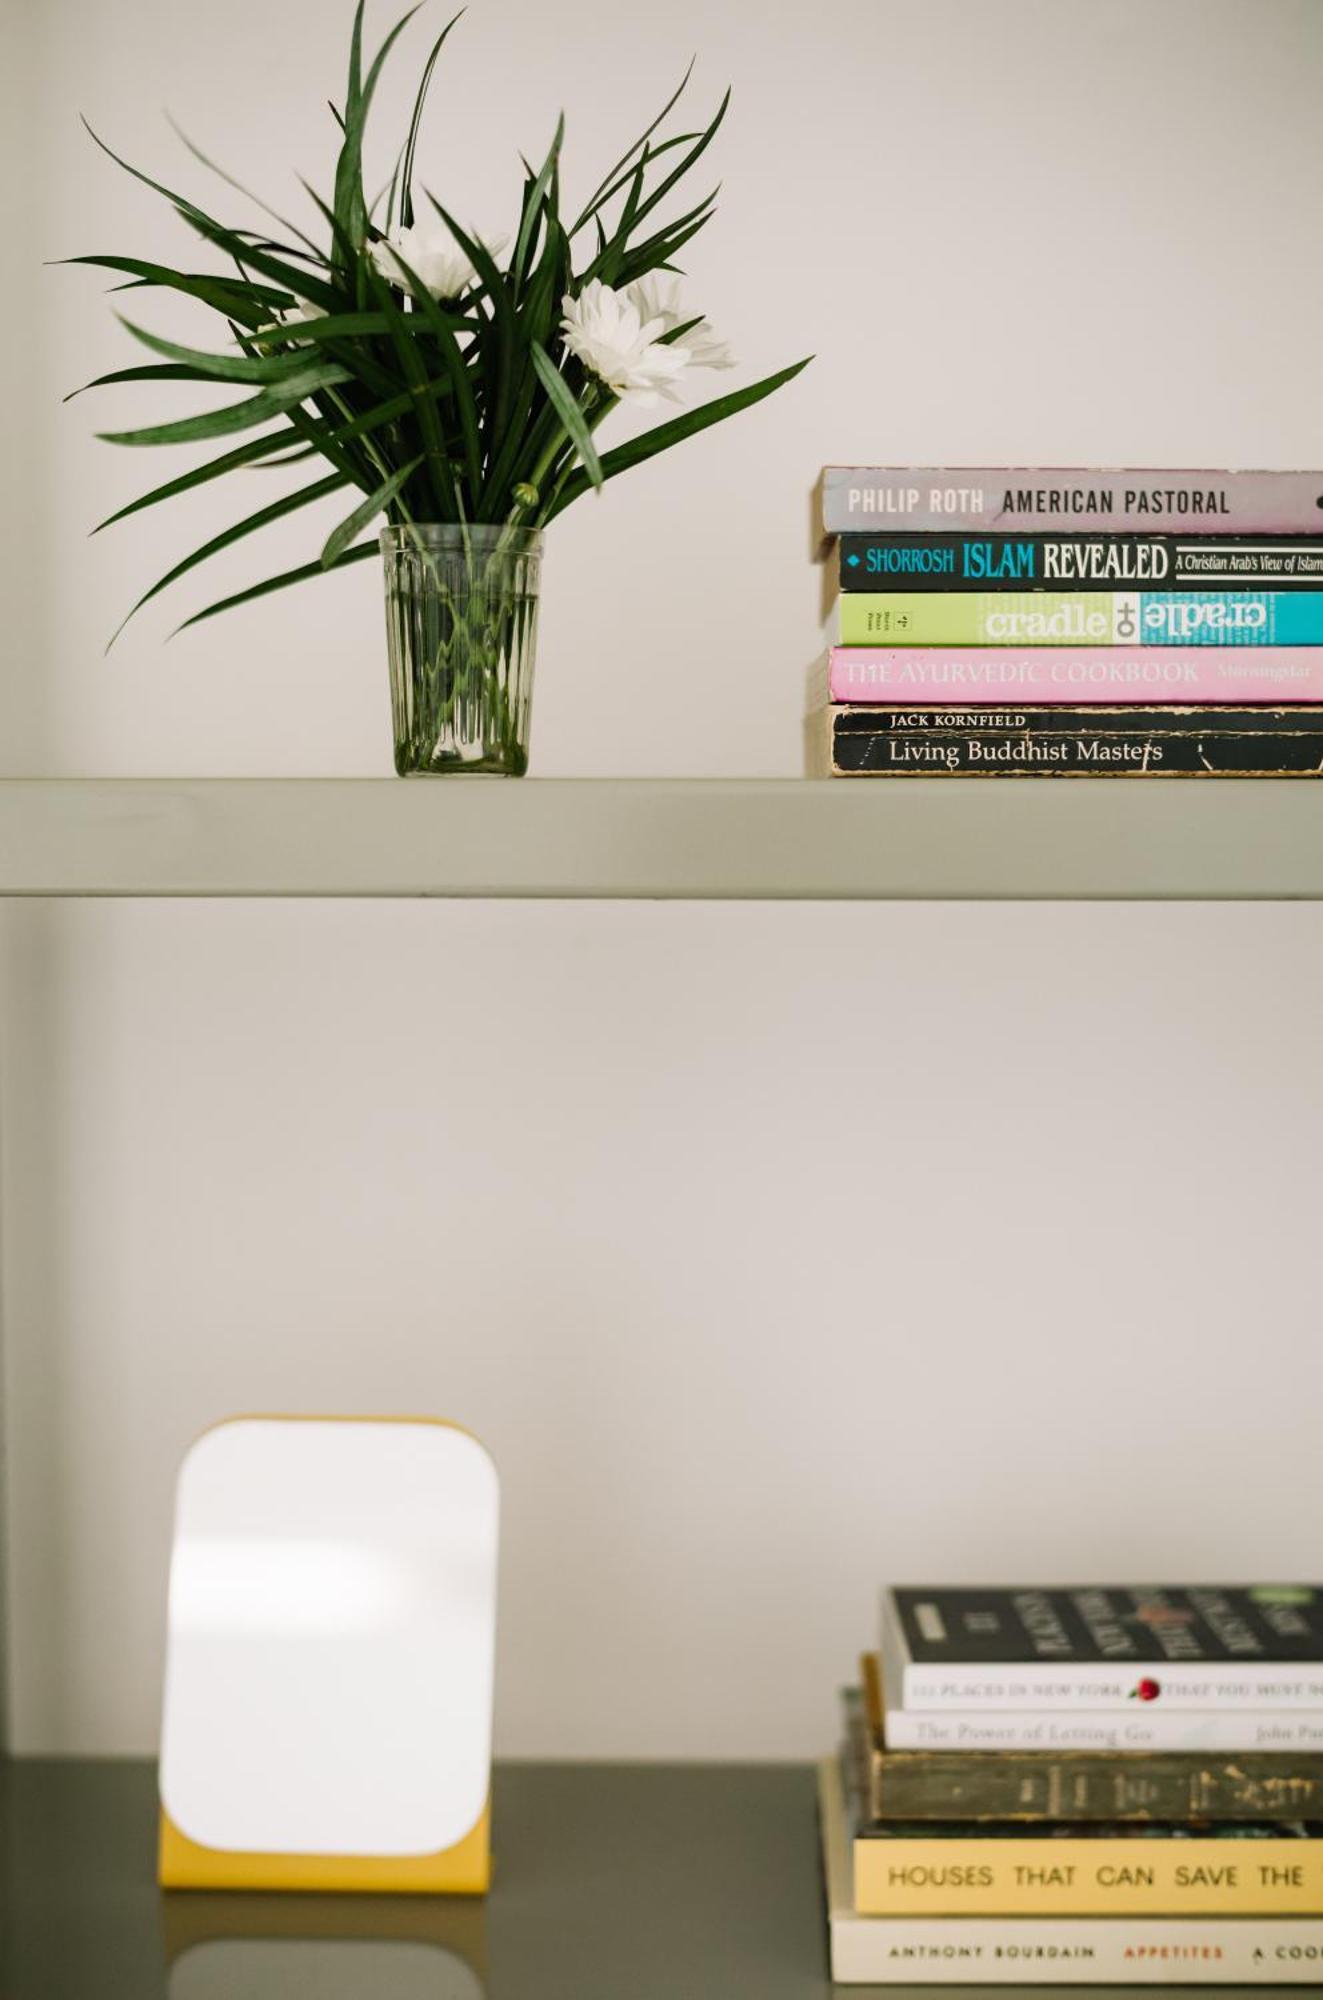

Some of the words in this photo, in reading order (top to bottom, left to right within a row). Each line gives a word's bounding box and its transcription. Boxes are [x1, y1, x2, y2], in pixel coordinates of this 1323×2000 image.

[848, 488, 919, 512] PHILIP
[930, 488, 984, 513] ROTH
[1002, 490, 1112, 513] AMERICAN
[1125, 490, 1230, 514] PASTORAL
[866, 548, 954, 573] SHORROSH
[963, 543, 1034, 578] ISLAM
[1043, 543, 1168, 579] REVEALED
[1175, 555, 1183, 570] A
[1185, 554, 1227, 570] Christian
[1229, 555, 1258, 571] Arab's
[1260, 555, 1282, 571] View
[1284, 555, 1296, 574] of
[985, 604, 1107, 638] cradle
[1145, 602, 1267, 636] cradle
[848, 663, 891, 683] THE
[899, 662, 1041, 684] AYURVEDIC
[1050, 663, 1199, 683] COOKBOOK
[890, 715, 929, 728] JACK
[934, 715, 1026, 727] KORNFIELD
[890, 741, 960, 767] Living
[968, 740, 1068, 761] Buddhist
[1075, 740, 1163, 761] Masters
[941, 1683, 1004, 1697] PLACES
[1008, 1683, 1027, 1697] IN
[1033, 1683, 1072, 1697] NEW
[1077, 1683, 1121, 1697] YORK
[1165, 1684, 1212, 1697] THAT
[1215, 1684, 1250, 1697] YOU
[917, 1723, 949, 1739] The
[957, 1723, 1016, 1739] Power
[1021, 1724, 1043, 1739] of
[1050, 1724, 1119, 1746] Letting
[1124, 1724, 1154, 1740] Go
[1256, 1725, 1293, 1743] John
[888, 1866, 994, 1887] HOUSES
[1014, 1866, 1077, 1886] THAT
[1096, 1866, 1154, 1887] CAN
[1174, 1866, 1238, 1887] SAVE
[1258, 1866, 1304, 1887] THE
[889, 1945, 983, 1958] ANTHONY
[994, 1945, 1095, 1958] BOURDAIN
[1124, 1945, 1224, 1959] APPETITES
[1252, 1946, 1265, 1959] A
[1275, 1945, 1323, 1960] COO
